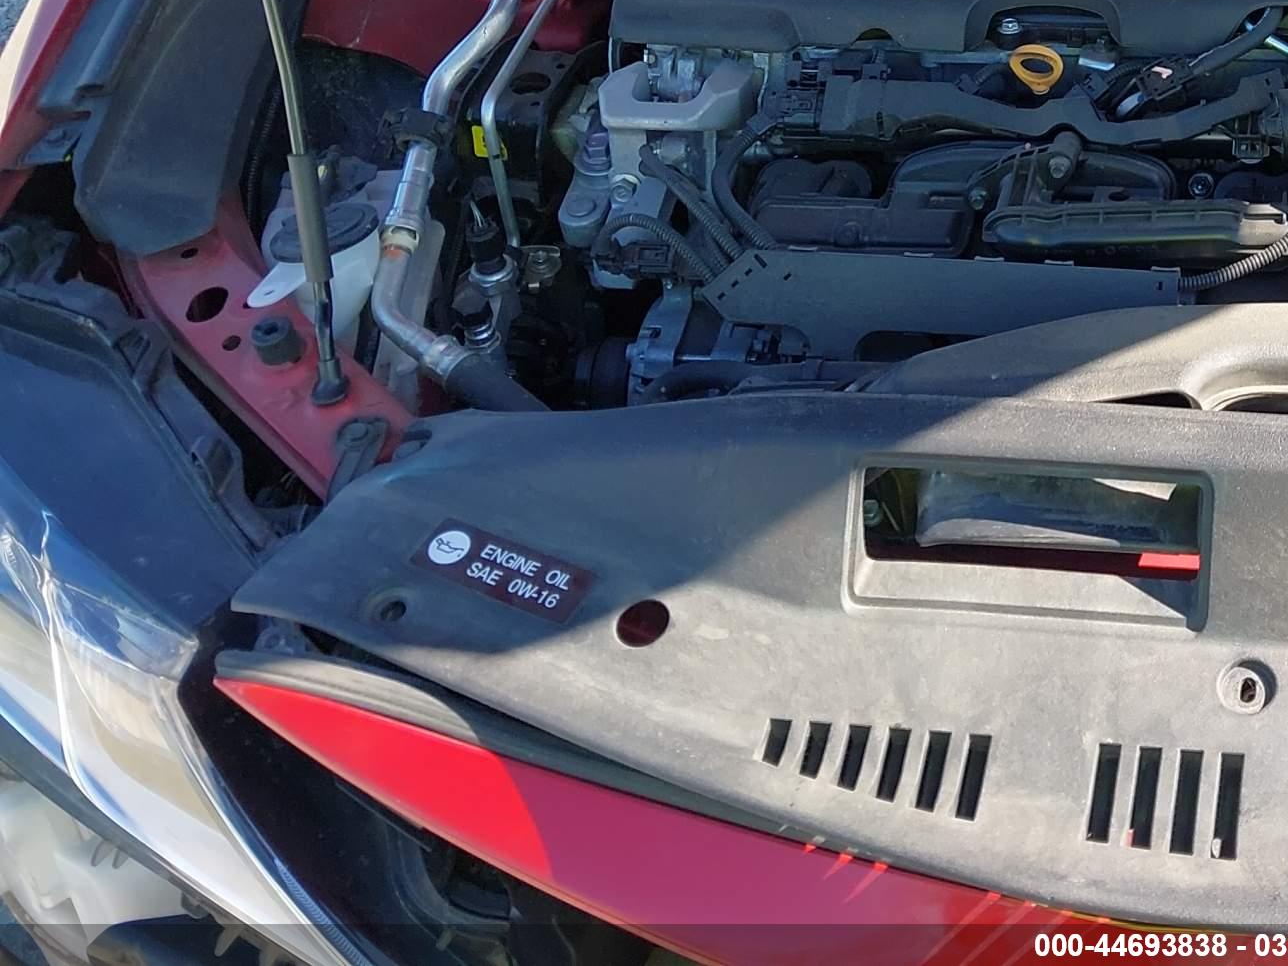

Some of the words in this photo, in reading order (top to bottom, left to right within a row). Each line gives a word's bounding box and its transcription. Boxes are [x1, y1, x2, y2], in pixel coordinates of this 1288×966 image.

[466, 561, 504, 586] SAE
[507, 578, 560, 609] 0W-16
[480, 543, 542, 577] ENGINE
[544, 569, 571, 591] OIL
